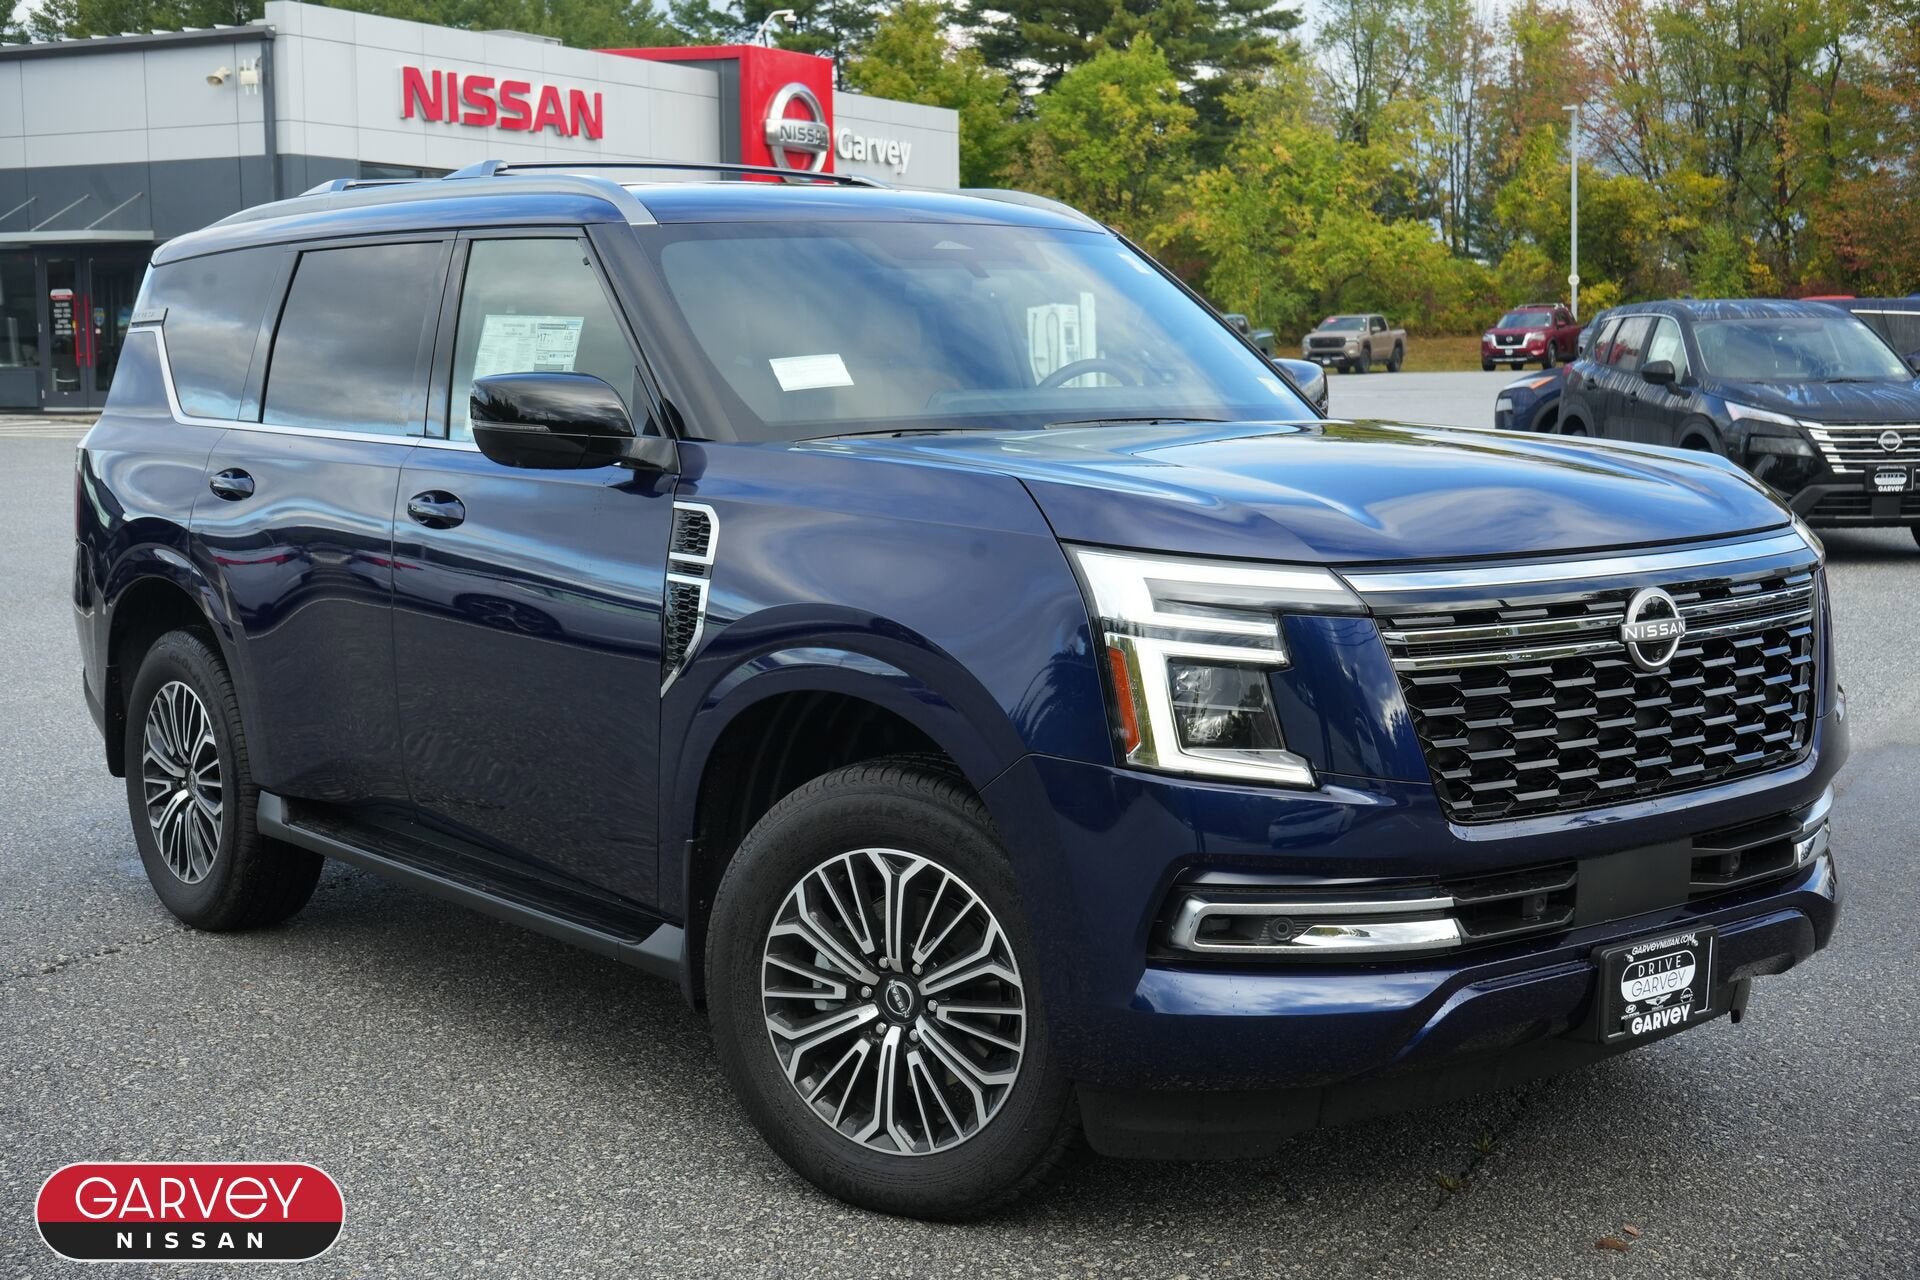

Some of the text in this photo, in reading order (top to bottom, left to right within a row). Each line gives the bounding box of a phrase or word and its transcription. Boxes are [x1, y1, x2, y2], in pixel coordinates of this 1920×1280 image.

[402, 66, 603, 139] NISSAN
[838, 128, 911, 174] Garvey
[1624, 620, 1685, 639] NISSAN
[1638, 956, 1681, 978] DRIVE
